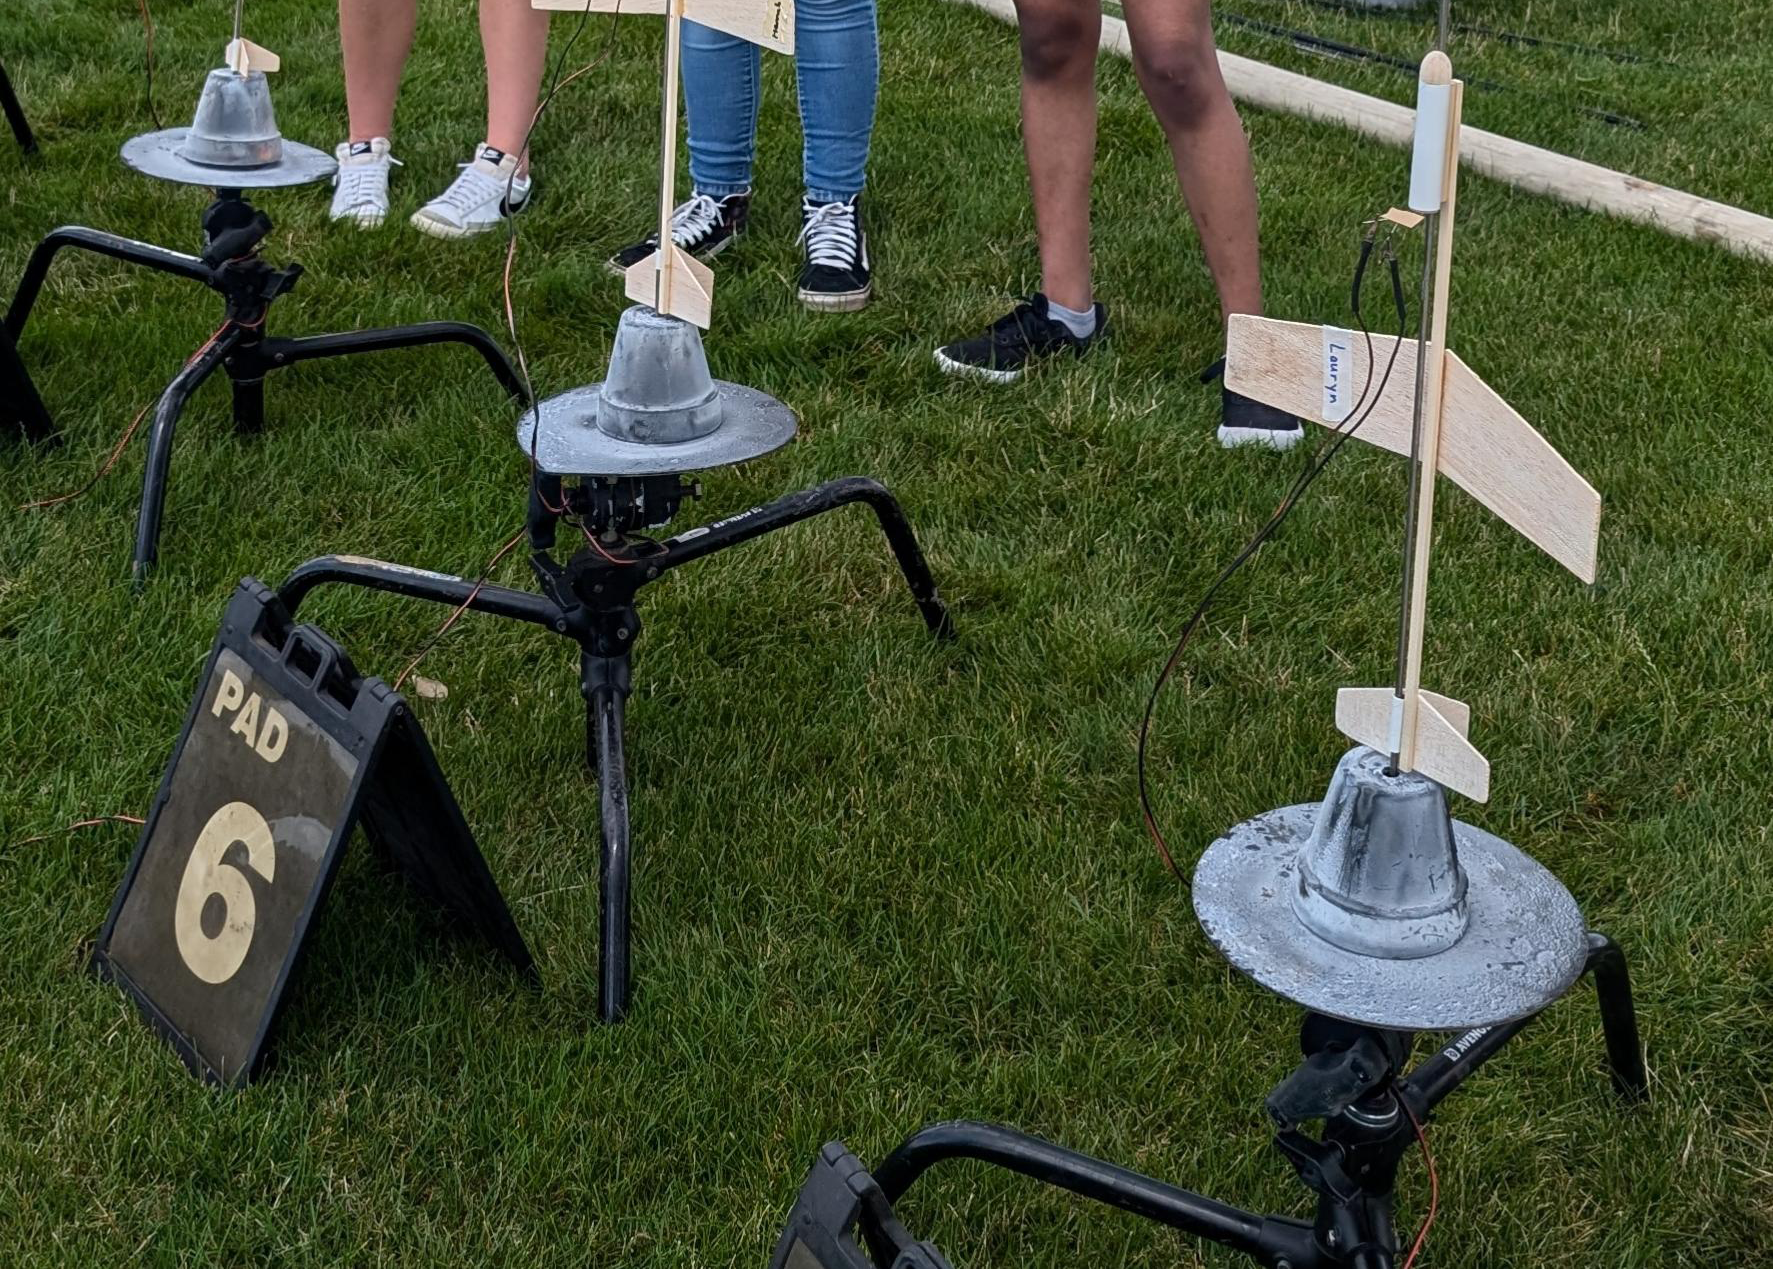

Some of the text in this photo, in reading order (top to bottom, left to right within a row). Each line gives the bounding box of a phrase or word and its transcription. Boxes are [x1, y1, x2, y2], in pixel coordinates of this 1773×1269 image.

[1324, 343, 1346, 404] Lauryn
[211, 669, 289, 763] PAD
[175, 801, 275, 984] 6
